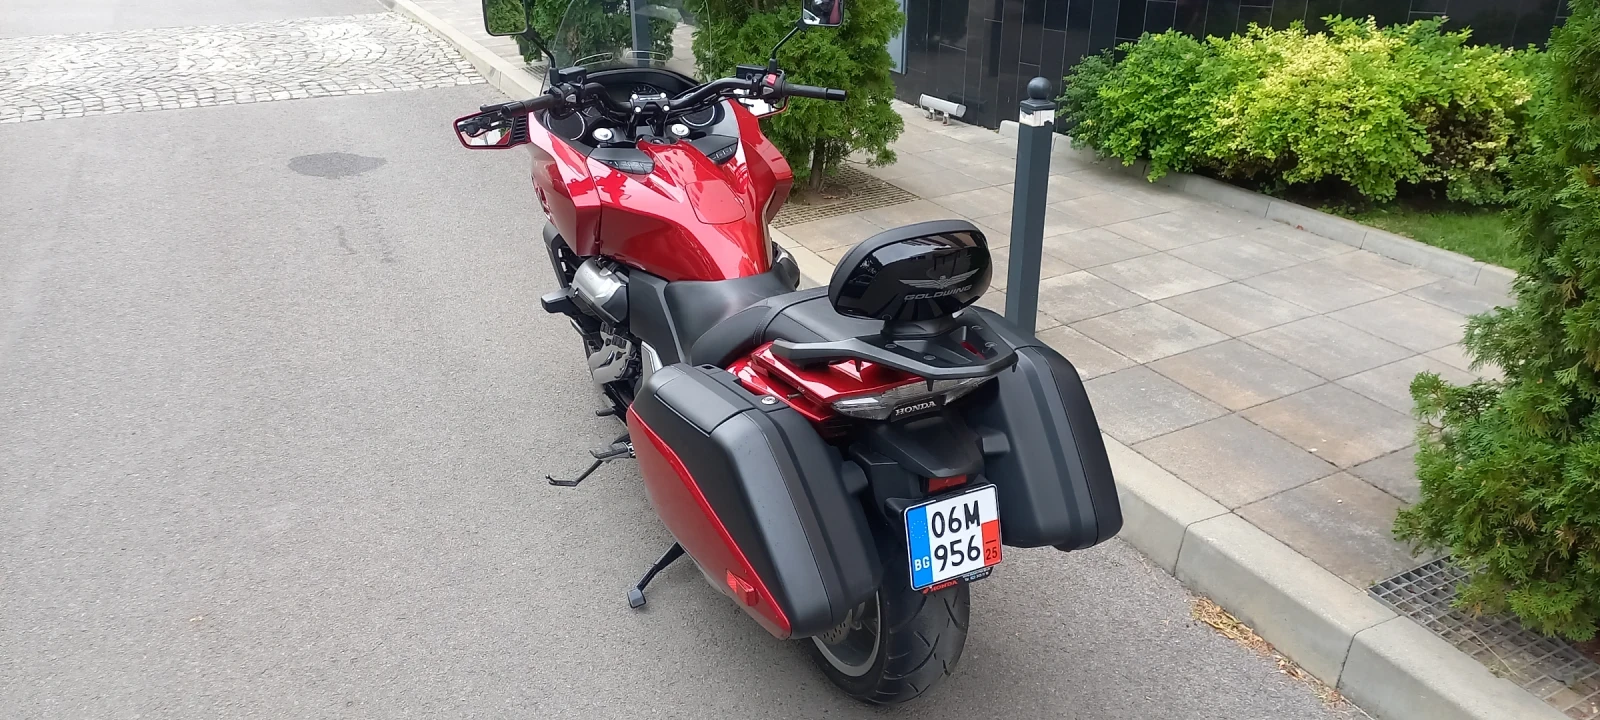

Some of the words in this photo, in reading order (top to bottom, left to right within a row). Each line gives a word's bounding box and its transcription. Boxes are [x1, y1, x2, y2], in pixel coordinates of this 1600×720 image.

[903, 284, 973, 301] GOLDWING
[894, 400, 937, 416] HONDA
[931, 500, 981, 538] 06M
[934, 534, 981, 572] 956
[985, 546, 998, 560] 25
[914, 556, 930, 571] BG
[930, 579, 958, 592] HONDA
